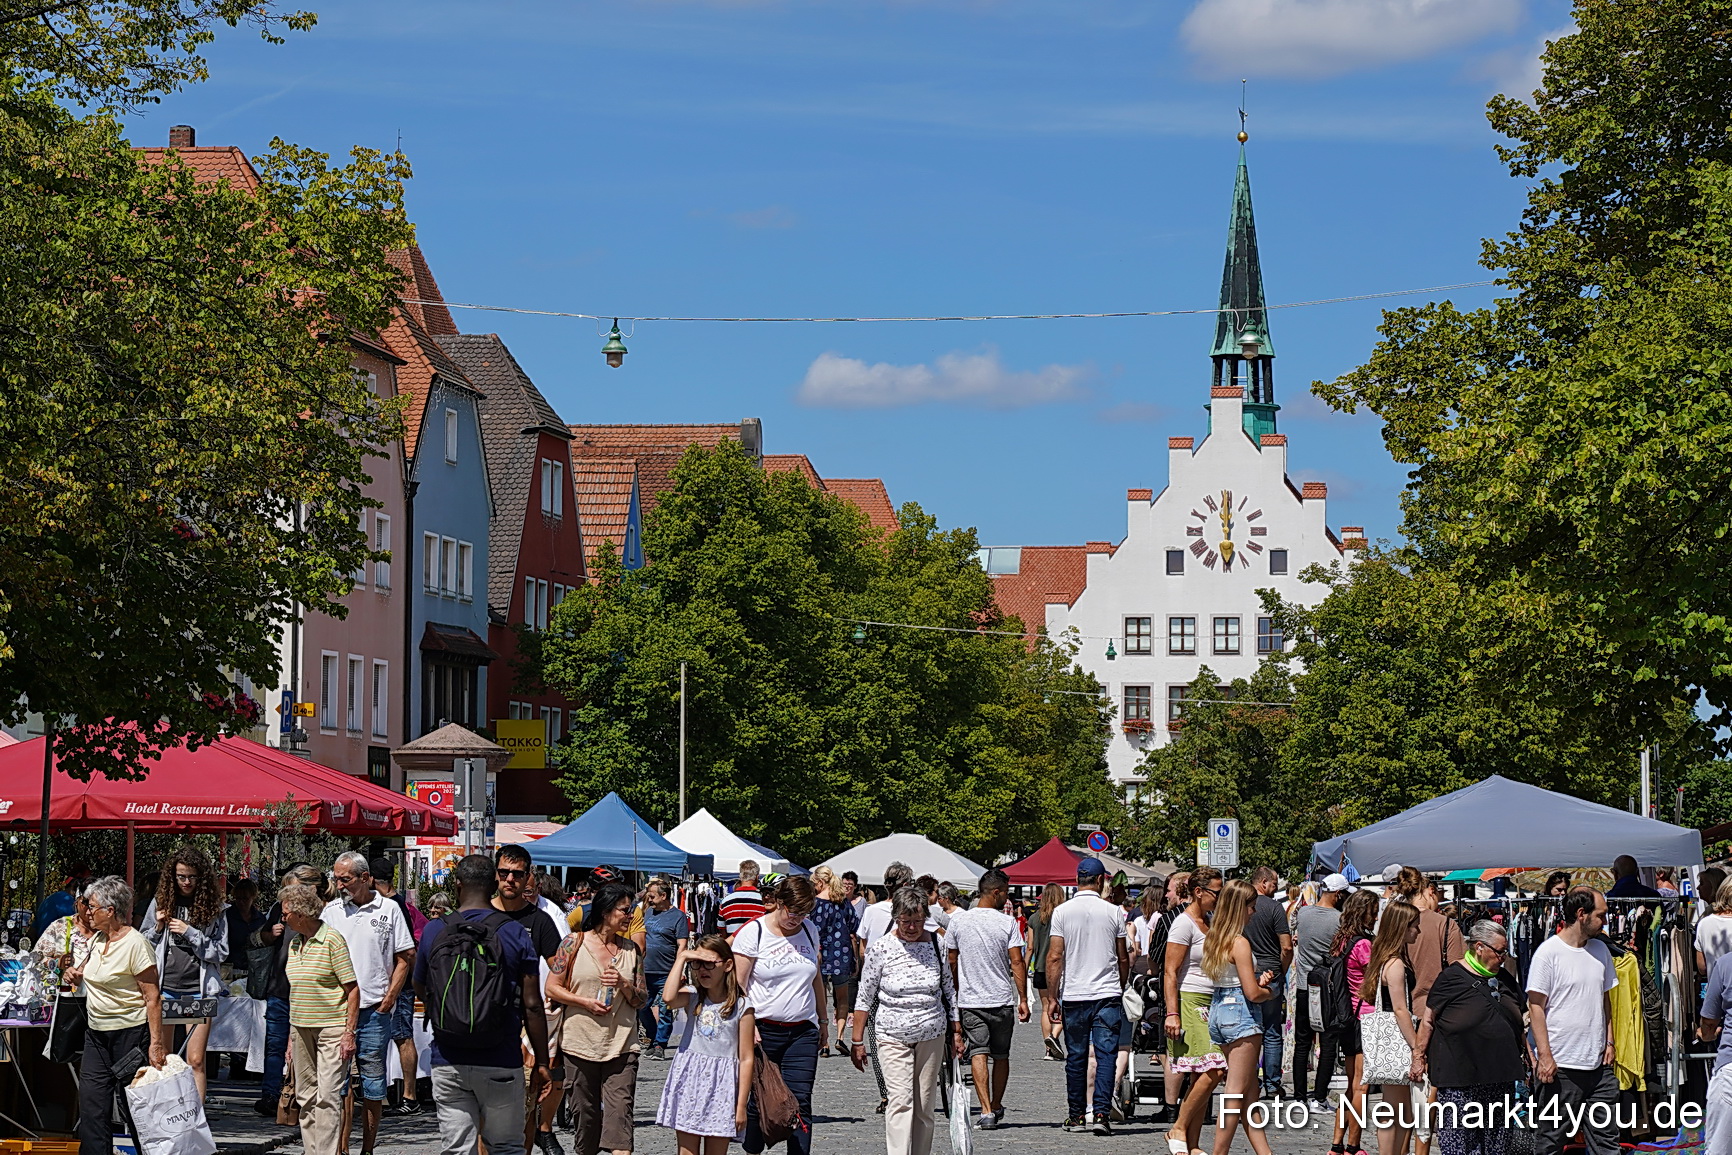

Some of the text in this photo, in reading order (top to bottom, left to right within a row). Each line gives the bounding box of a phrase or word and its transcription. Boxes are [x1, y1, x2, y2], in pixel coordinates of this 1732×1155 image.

[124, 802, 158, 814] Hotel
[160, 803, 225, 815] Restaurant
[795, 945, 810, 954] LES
[763, 956, 814, 969] VACANC
